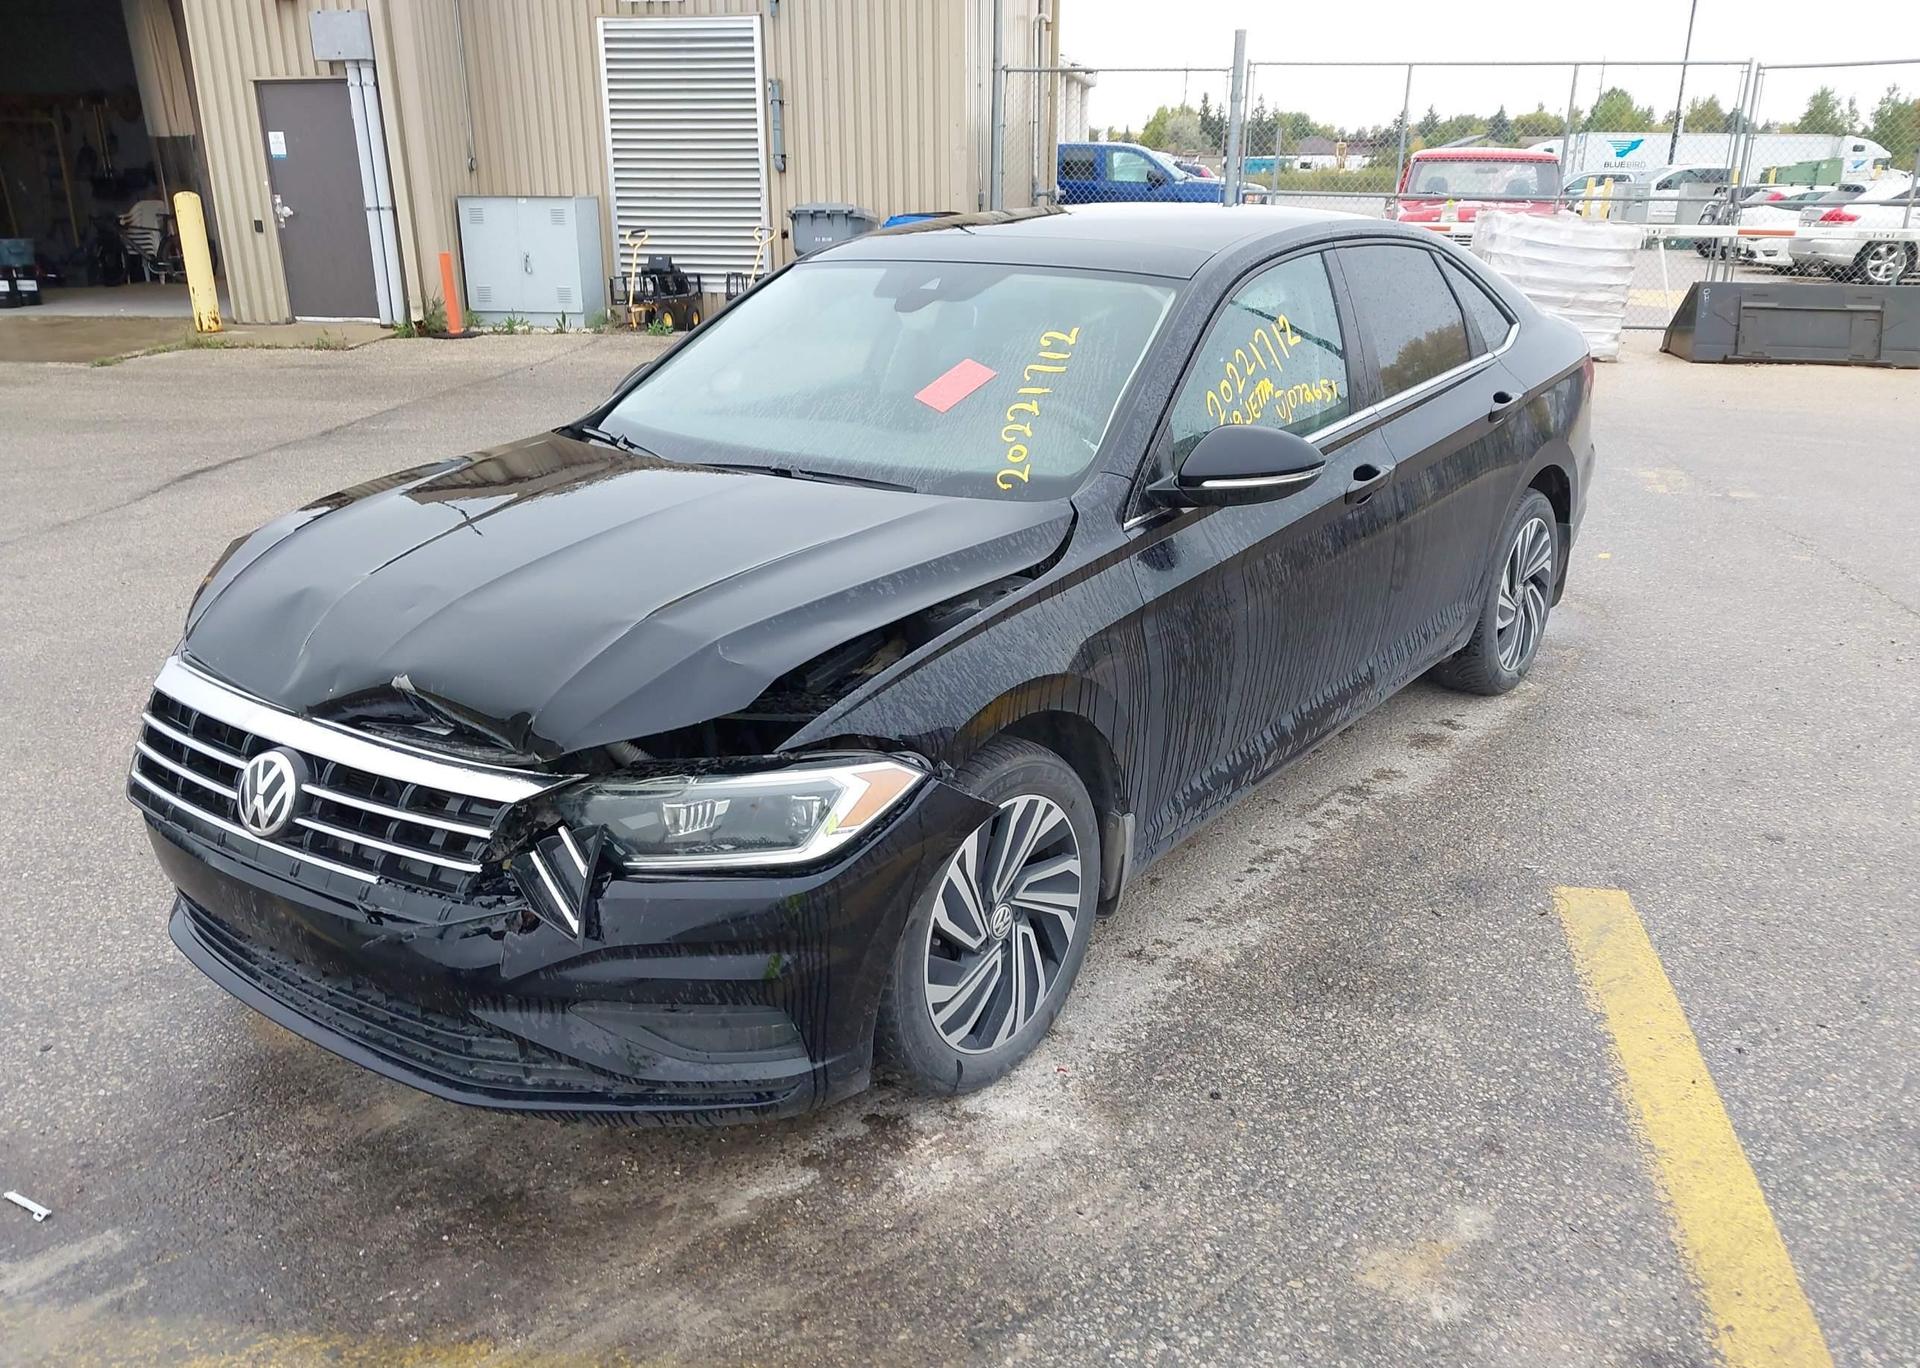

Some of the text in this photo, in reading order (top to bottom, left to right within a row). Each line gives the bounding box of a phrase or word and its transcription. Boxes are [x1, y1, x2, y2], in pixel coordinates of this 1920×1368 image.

[996, 327, 1080, 490] 20221712
[1206, 314, 1301, 426] 20221712
[239, 751, 296, 836] VW
